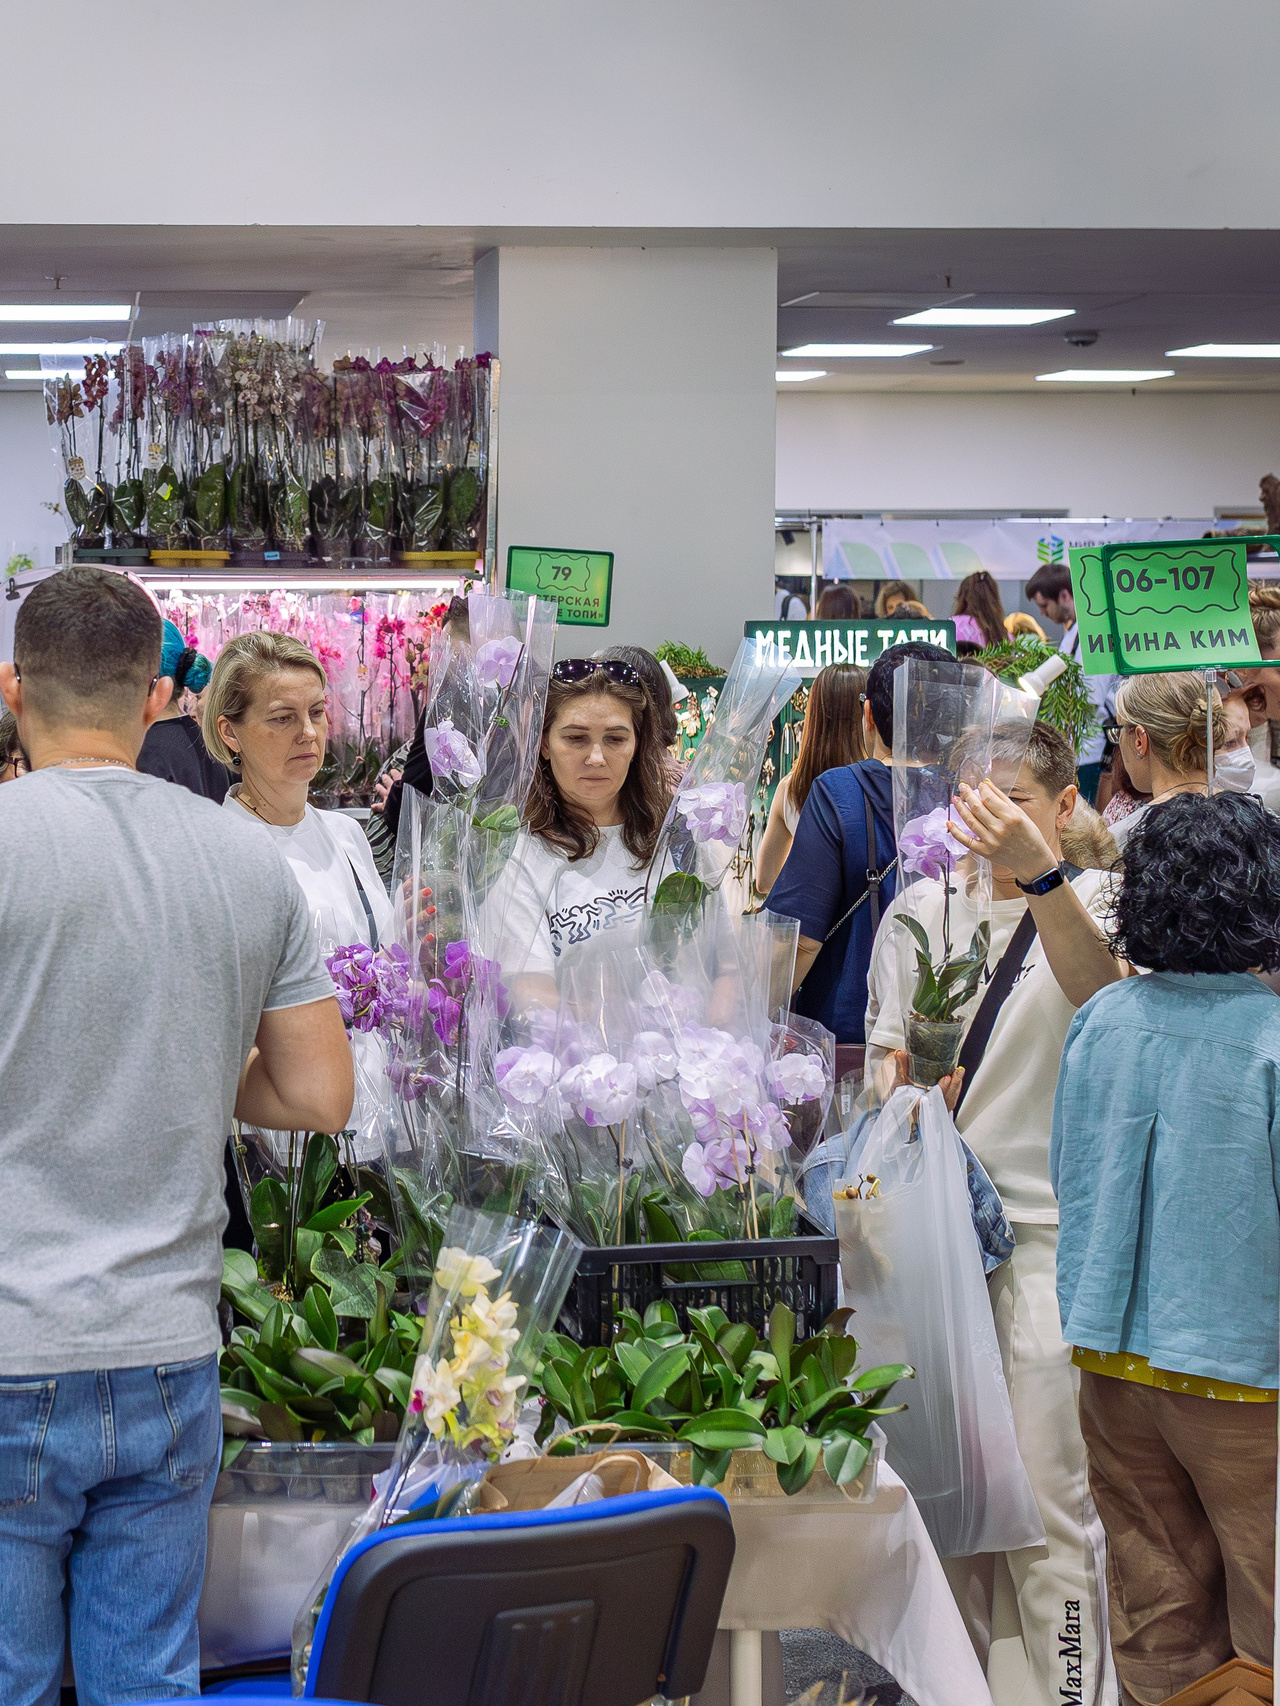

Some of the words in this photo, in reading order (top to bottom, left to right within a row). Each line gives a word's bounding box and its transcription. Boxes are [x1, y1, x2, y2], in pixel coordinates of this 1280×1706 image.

[552, 566, 572, 581] 79
[1114, 566, 1215, 594] 06-107
[755, 628, 870, 668] МЕДНЫЕ
[1190, 628, 1250, 649] КИМ
[1058, 1599, 1083, 1706] MaxMara
